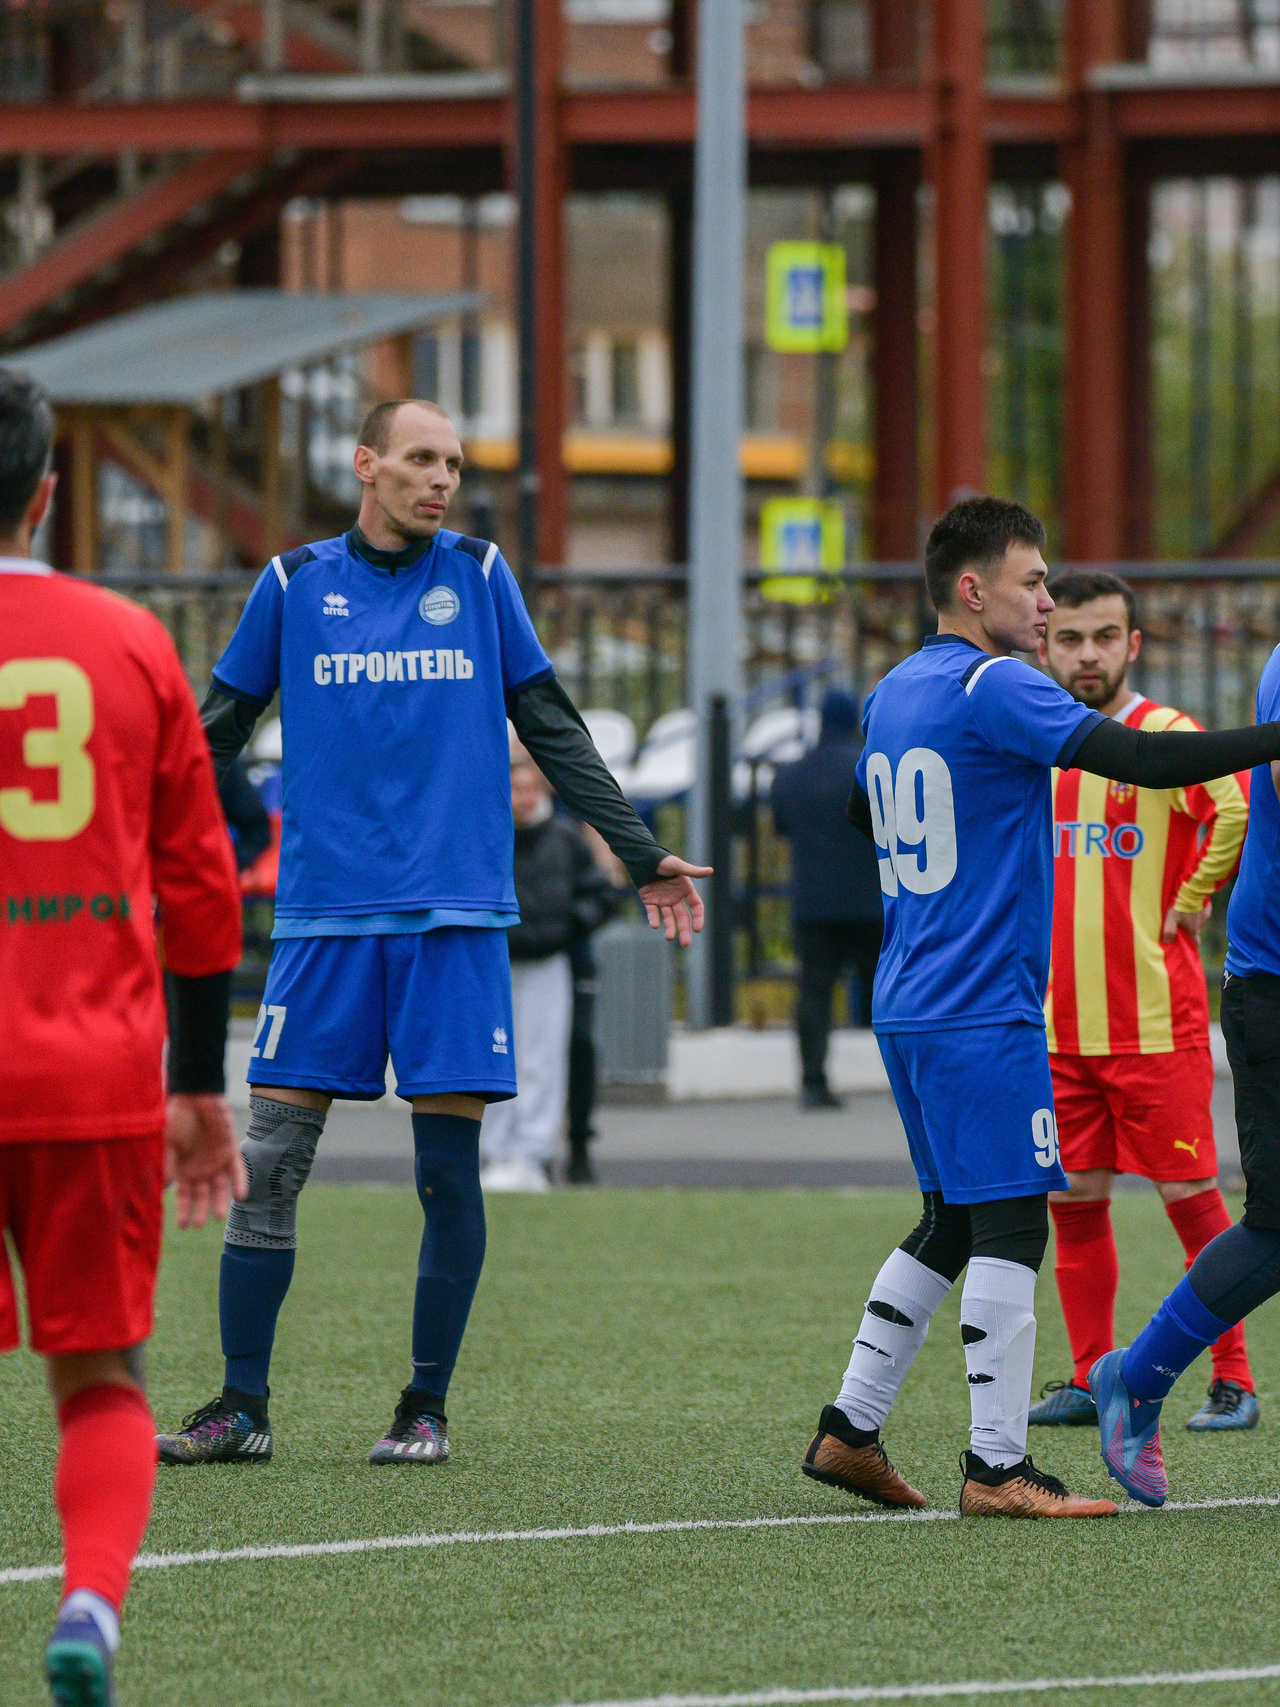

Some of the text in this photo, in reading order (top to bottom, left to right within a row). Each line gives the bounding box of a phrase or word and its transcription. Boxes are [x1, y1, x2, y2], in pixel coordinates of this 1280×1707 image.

[322, 606, 350, 617] errea
[313, 649, 474, 686] СТРОИТЕЛЬ
[0, 657, 96, 842] 3
[866, 747, 957, 898] 99
[0, 894, 129, 923] НИРО
[1031, 1108, 1060, 1168] 9
